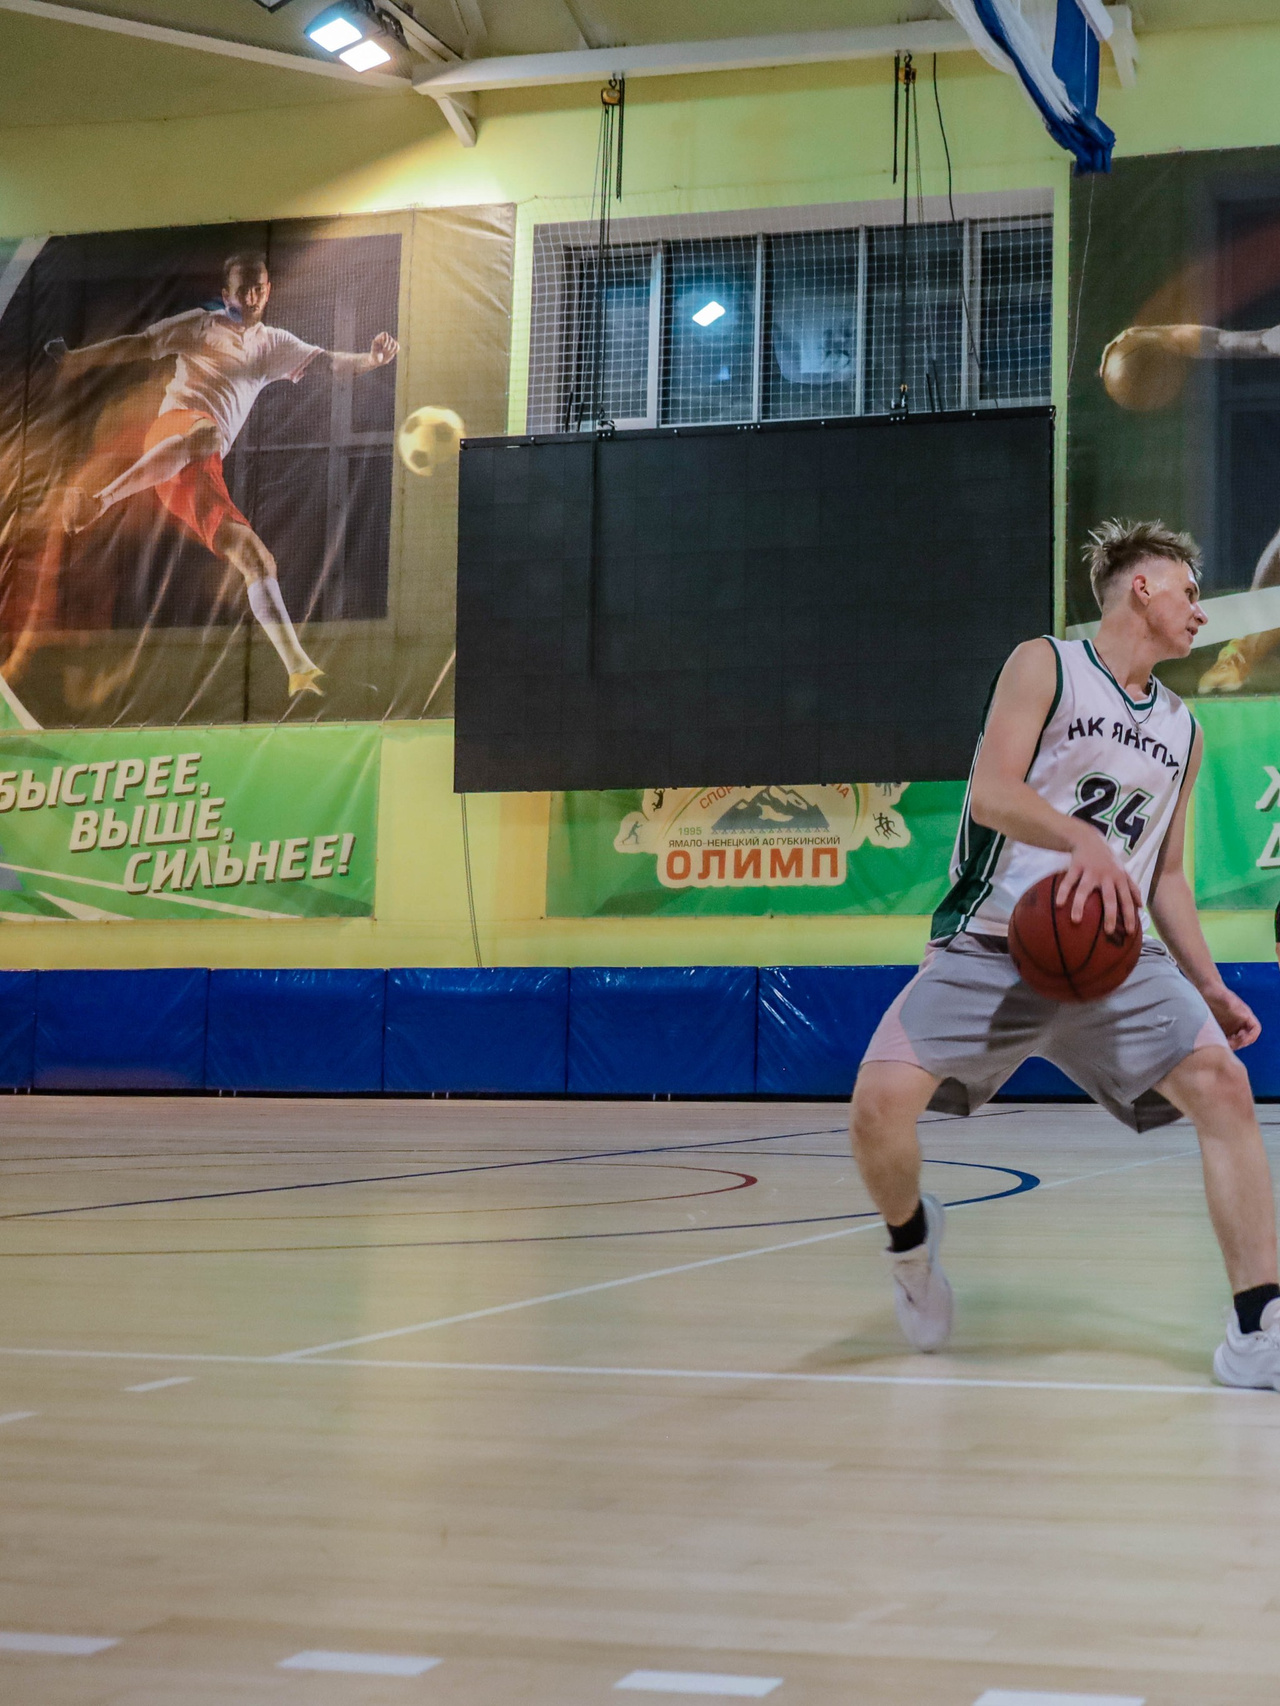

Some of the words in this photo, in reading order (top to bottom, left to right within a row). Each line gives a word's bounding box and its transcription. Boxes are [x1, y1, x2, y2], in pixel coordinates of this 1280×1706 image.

[1068, 716, 1106, 741] НК
[0, 753, 210, 813] БЫСТРЕЕ,
[69, 798, 234, 853] ВЫШЕ,
[678, 827, 702, 836] 1995
[1068, 772, 1154, 855] 24
[123, 833, 355, 895] СИЛЬНЕЕ!
[666, 847, 839, 880] ОЛИМП
[669, 837, 759, 848] ЯМАЛО-НЕНЕЦКИЙ
[762, 837, 775, 846] АО
[776, 836, 841, 846] ГУБКИНСКИЙ
